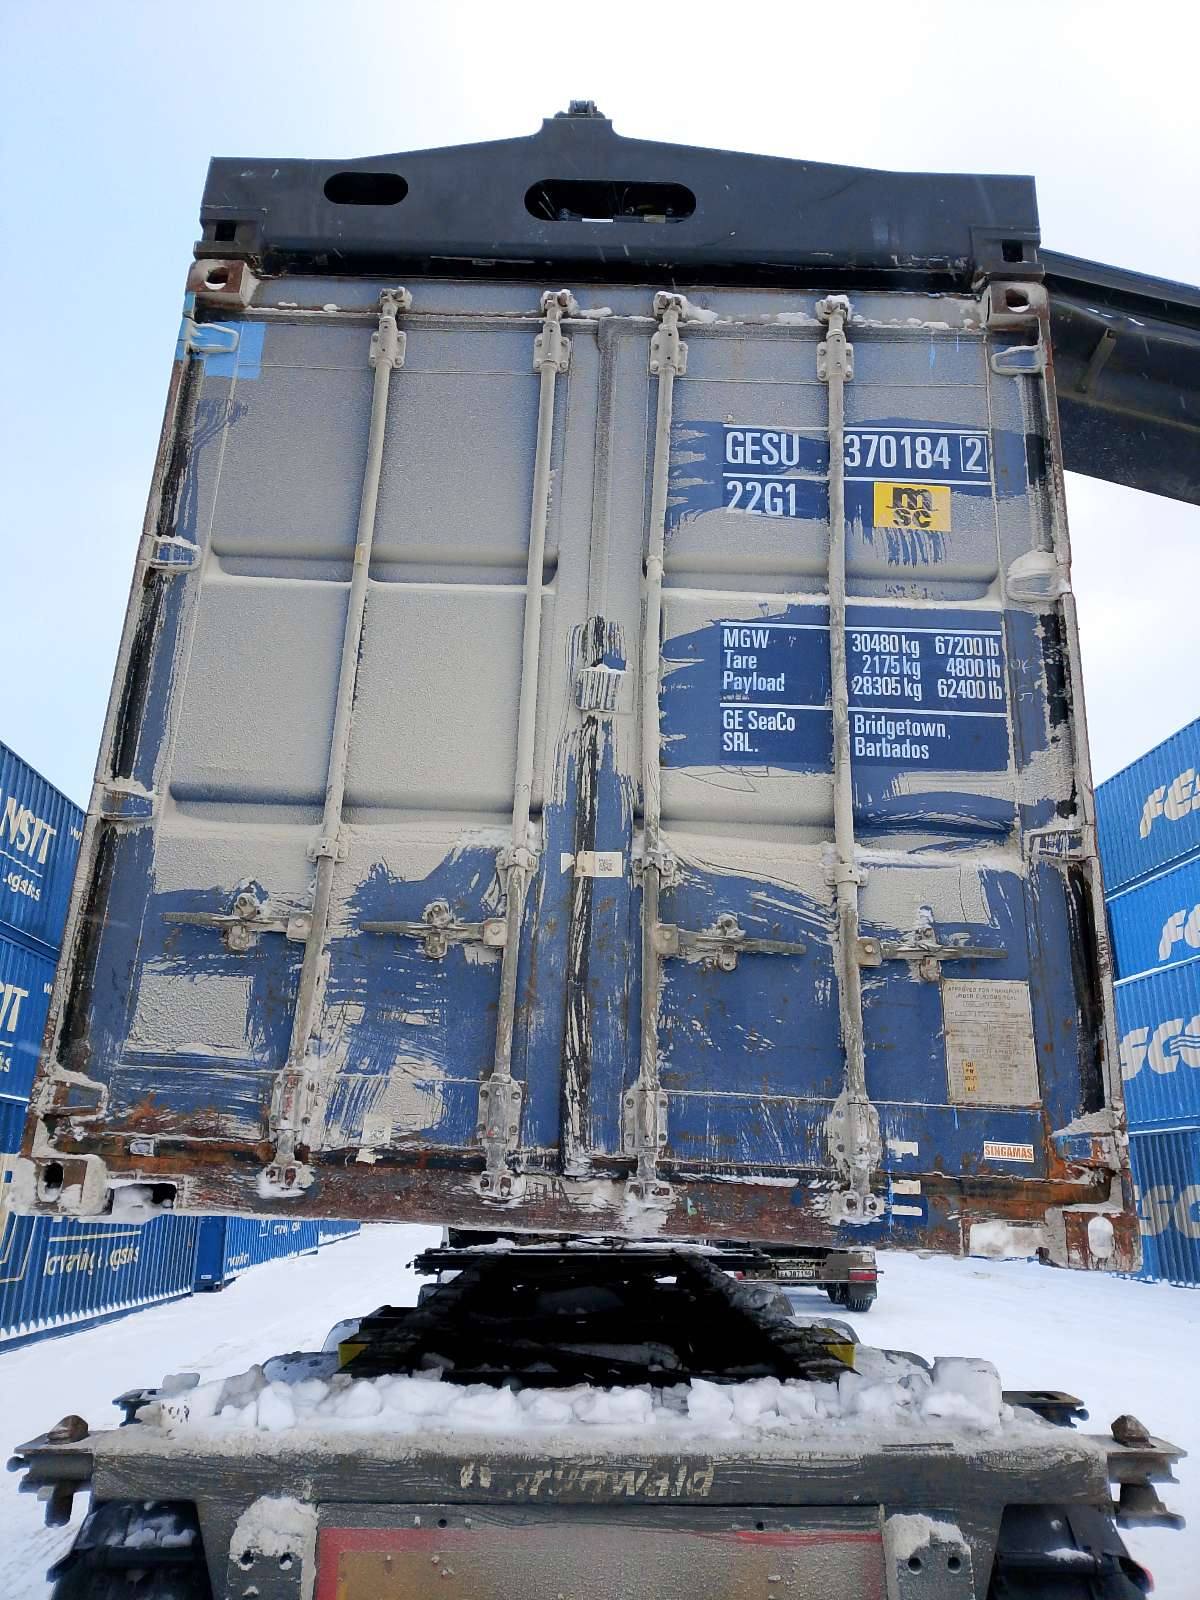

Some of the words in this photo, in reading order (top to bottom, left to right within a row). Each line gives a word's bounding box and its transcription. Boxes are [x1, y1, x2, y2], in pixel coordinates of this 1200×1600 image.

[725, 430, 800, 467] GESU
[843, 433, 952, 470] 370184
[965, 437, 984, 471] 2
[726, 480, 797, 517] 22G1
[723, 628, 770, 649] MGW
[851, 633, 899, 654] 30480
[901, 635, 920, 658] kg
[935, 636, 983, 656] 67200
[985, 637, 1000, 657] lb
[723, 650, 758, 669] Tare
[862, 654, 900, 675] 2175
[903, 657, 921, 680] kg
[946, 657, 985, 678] 4800
[986, 658, 1001, 678] lb
[723, 671, 785, 695] Payload
[853, 675, 901, 696] 28305
[904, 678, 922, 702] kg
[937, 678, 986, 700] 62400
[988, 680, 1003, 700] lb
[723, 709, 743, 730] GE
[747, 710, 796, 732] SeaCo
[854, 713, 951, 740] Bridgetown,
[723, 730, 759, 753] SRL.
[854, 736, 930, 760] Barbados
[984, 1145, 1033, 1159] SINGAMAS
